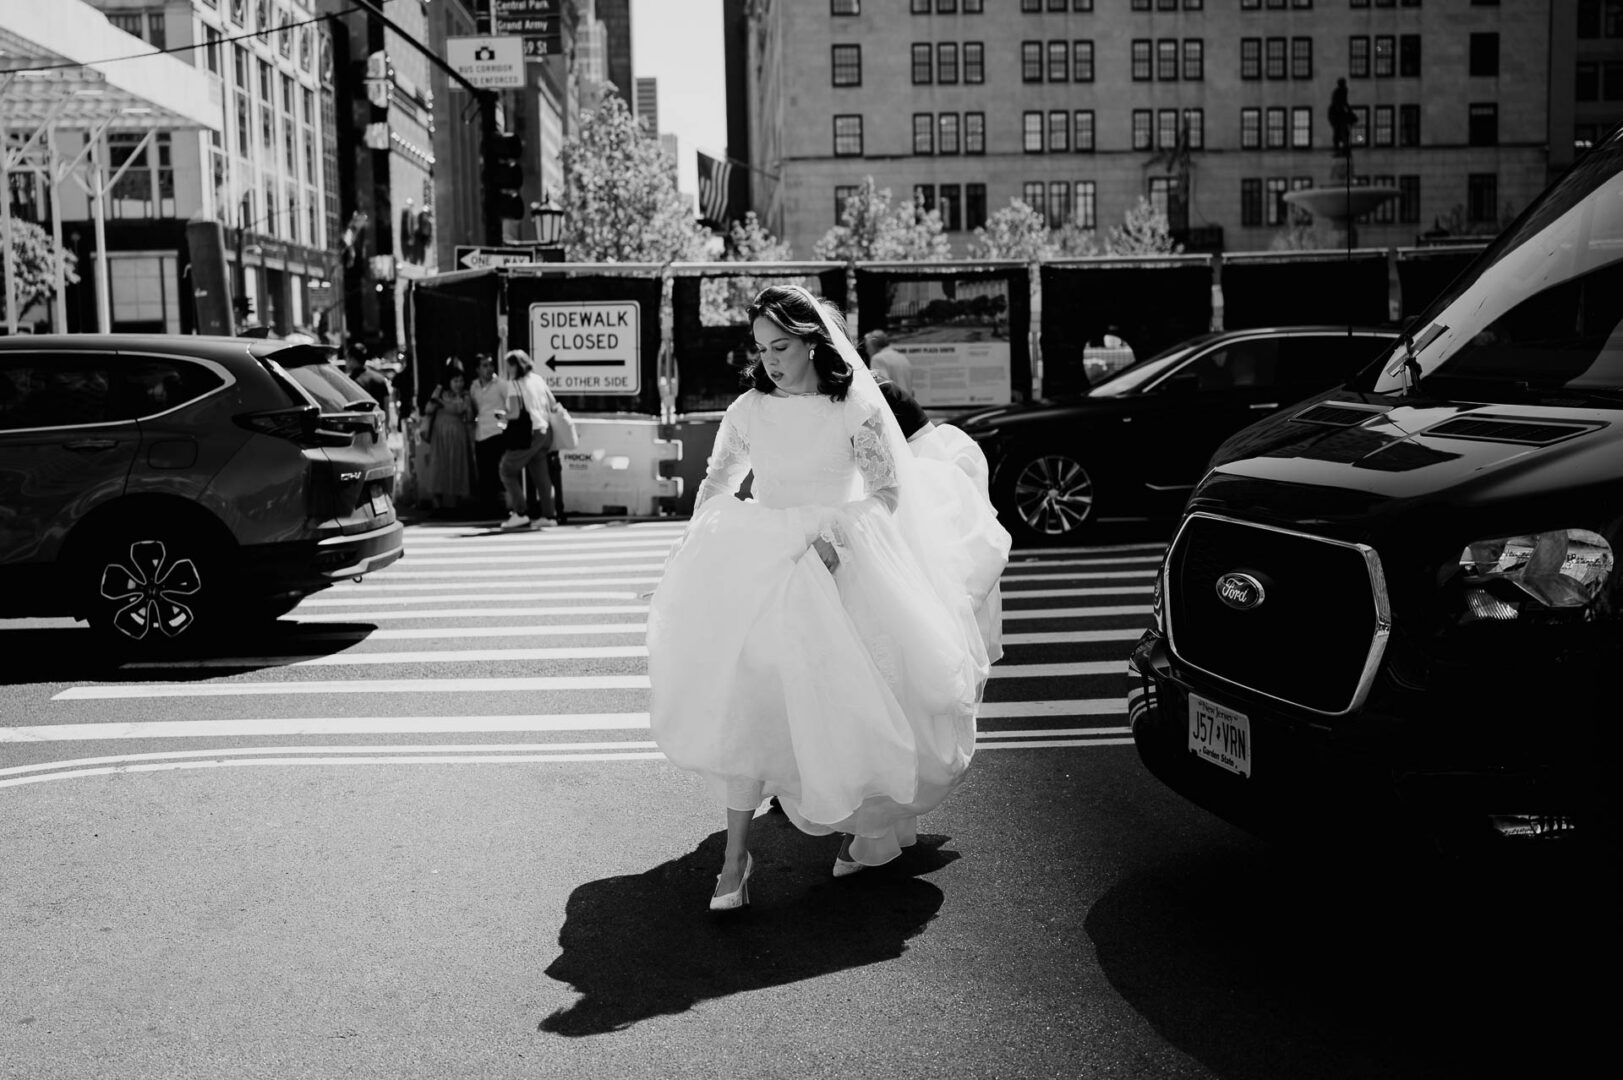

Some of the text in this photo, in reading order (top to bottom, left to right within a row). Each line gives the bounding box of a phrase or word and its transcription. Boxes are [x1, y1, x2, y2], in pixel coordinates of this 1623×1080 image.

[497, 0, 549, 10] Central Park
[498, 20, 548, 32] Grand Army
[537, 40, 547, 54] St
[458, 64, 512, 73] BUS CORRIDOR
[480, 75, 519, 84] ENFORCED
[471, 256, 490, 266] ONE
[540, 311, 628, 328] SIDEWALK
[550, 333, 619, 350] CLOSED
[565, 376, 600, 388] OTHER
[604, 376, 629, 387] SIDE
[1221, 577, 1249, 603] Ford
[1202, 701, 1233, 723] New Jersey
[1193, 711, 1246, 761] J57 VRN
[1203, 745, 1235, 767] Garden State
